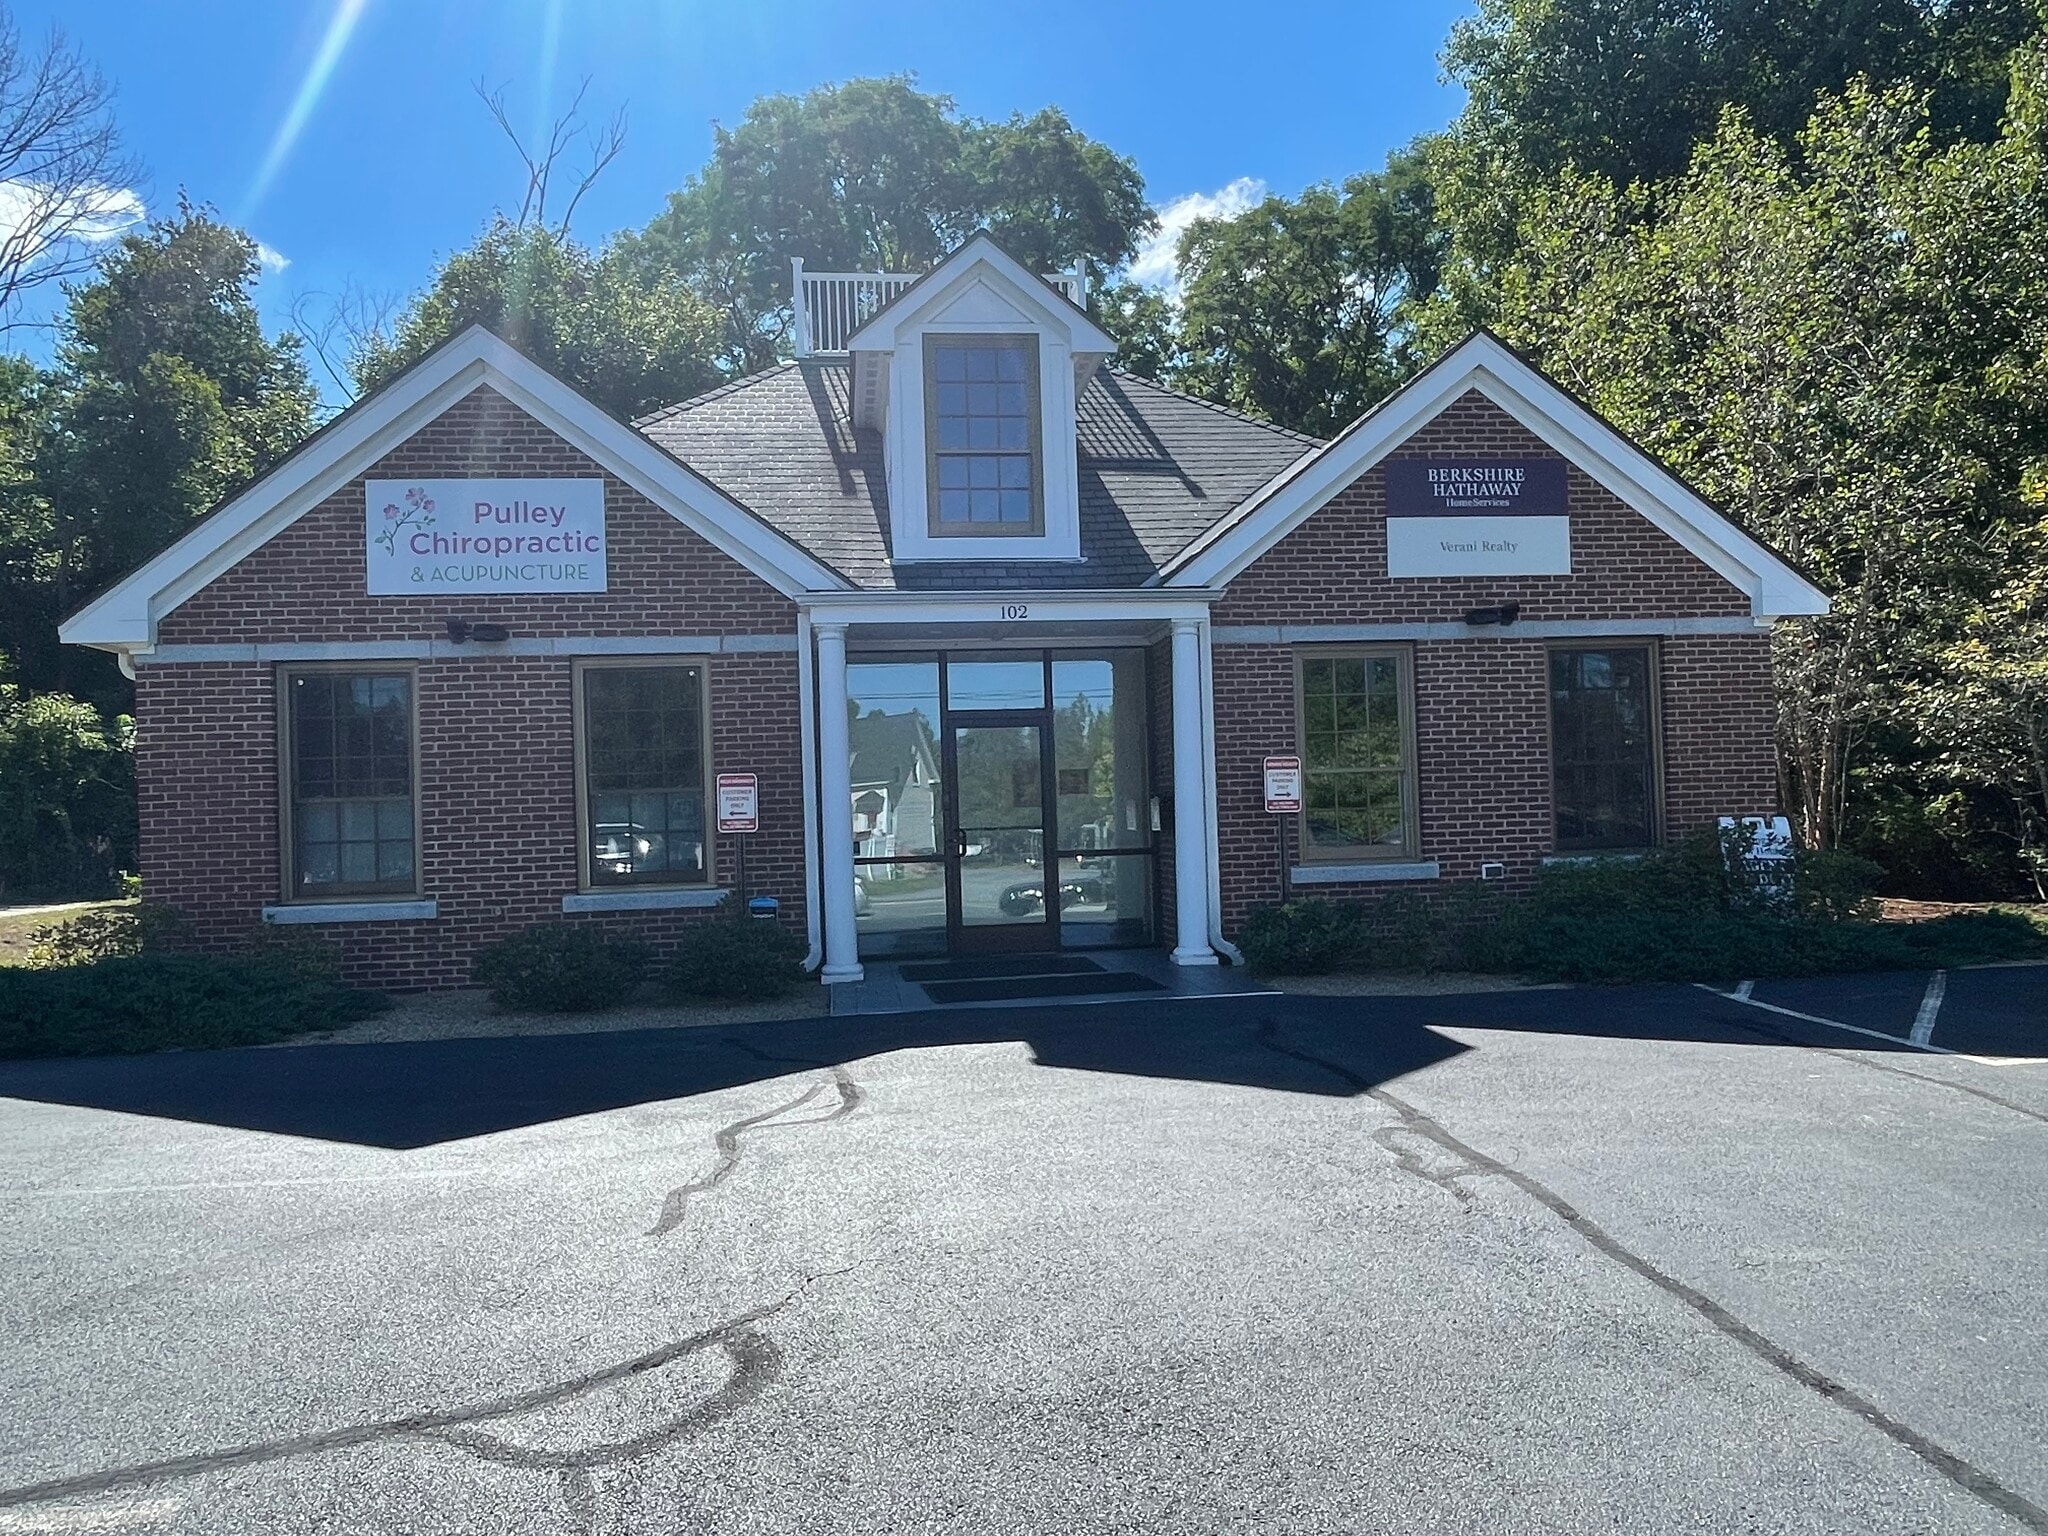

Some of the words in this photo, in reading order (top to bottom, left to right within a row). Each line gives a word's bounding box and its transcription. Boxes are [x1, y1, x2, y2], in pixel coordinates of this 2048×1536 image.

[1428, 468, 1525, 482] BERKSHIRE
[1433, 483, 1521, 496] HATHAWAY
[1446, 498, 1510, 507] HomeServices
[474, 501, 566, 527] Pulley
[409, 530, 600, 558] Chiropractic
[1440, 540, 1477, 552] Verani
[1481, 540, 1518, 554] Realty
[410, 566, 425, 582] &
[431, 564, 589, 582] ACUPUNCTURE
[1001, 605, 1028, 619] 102
